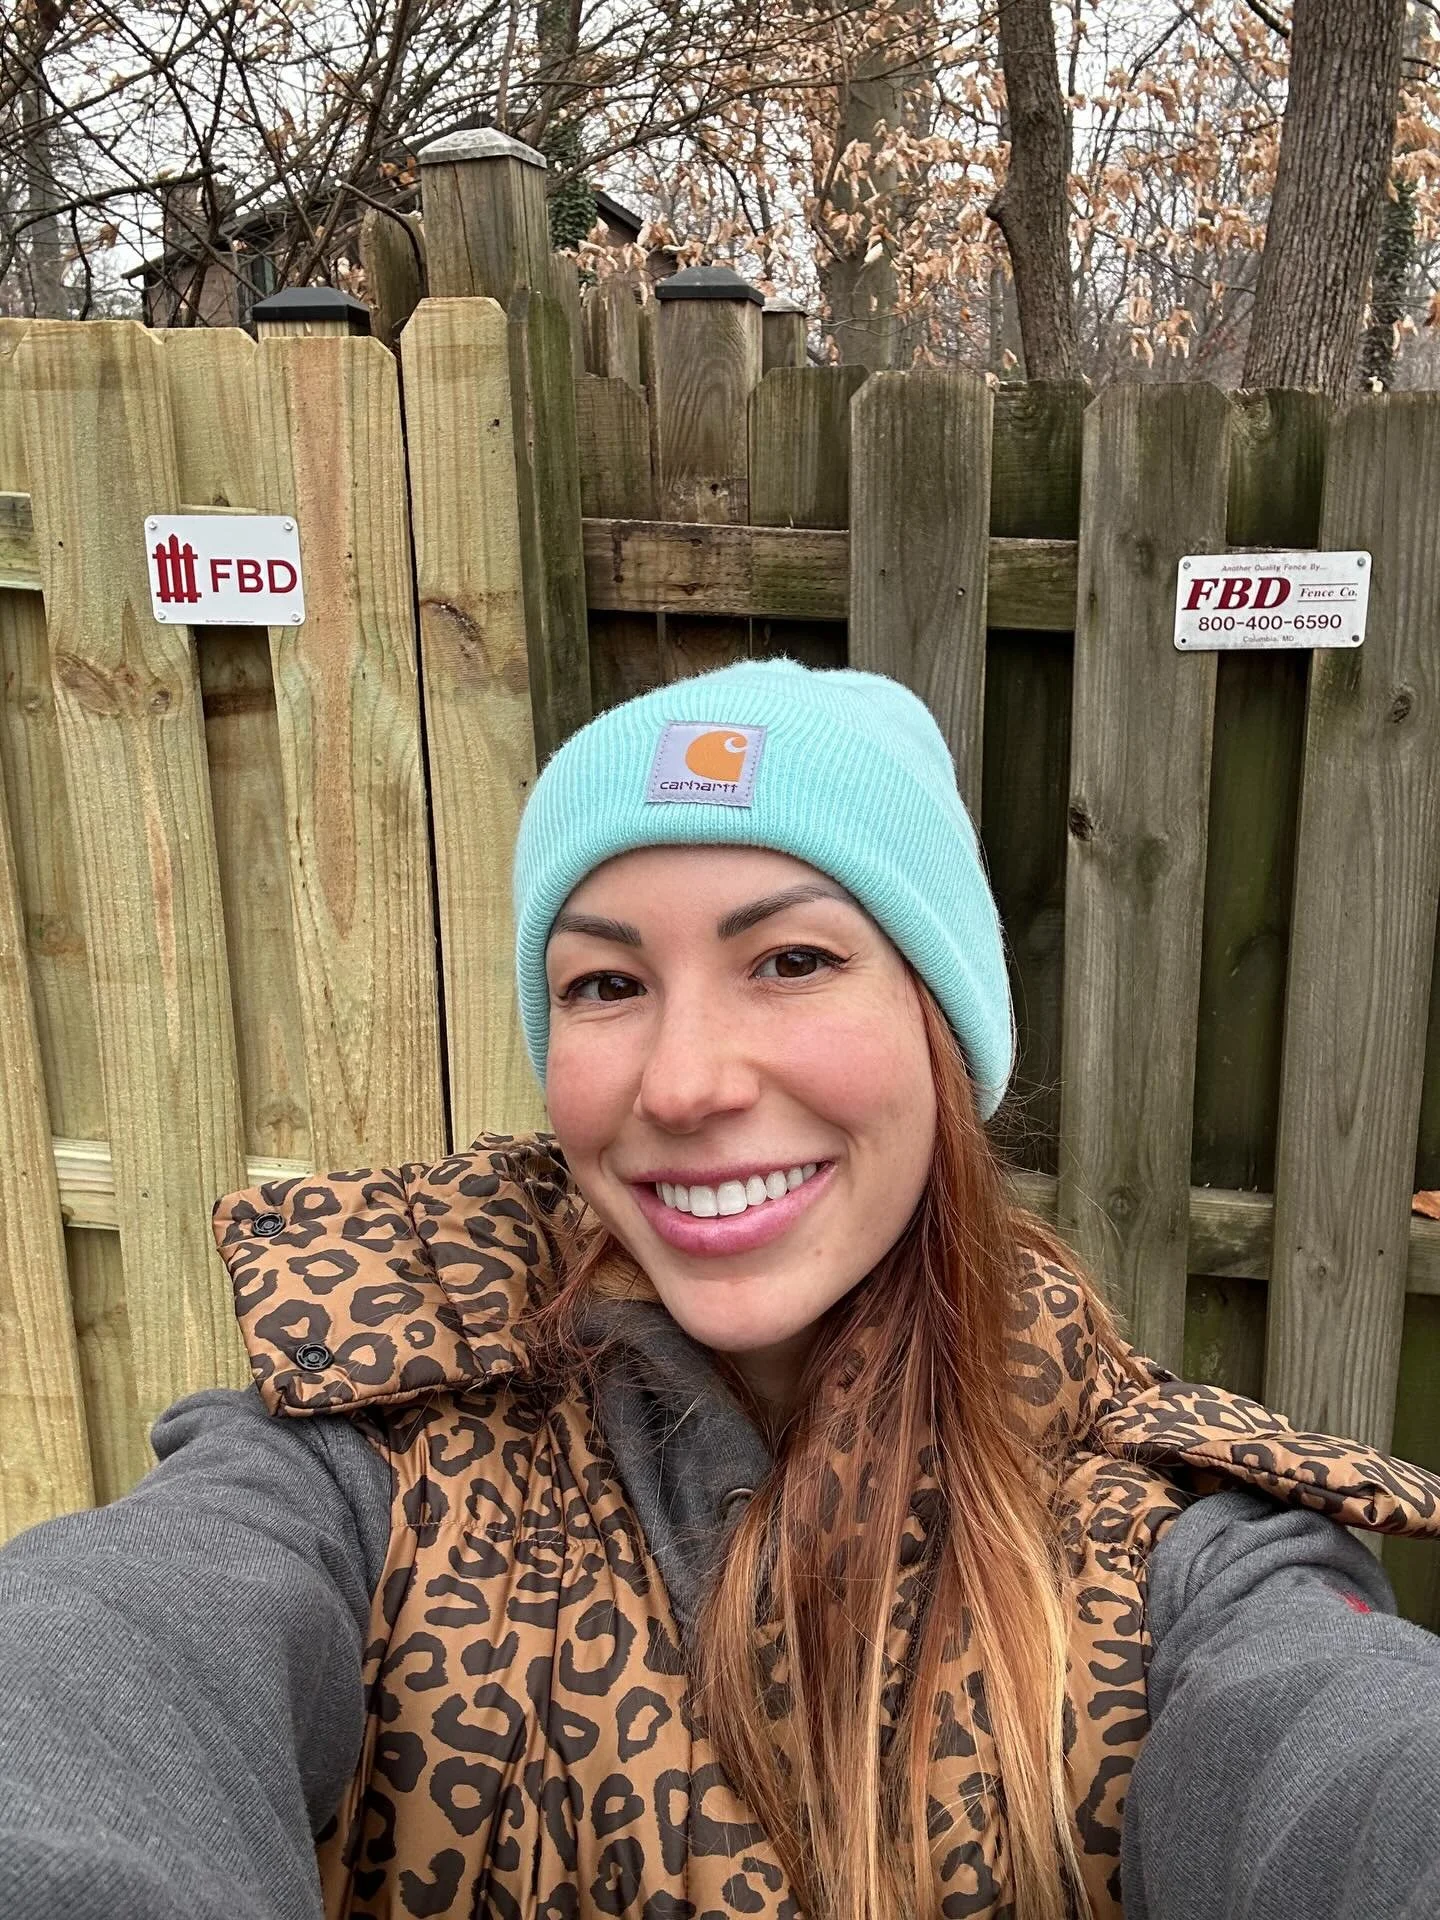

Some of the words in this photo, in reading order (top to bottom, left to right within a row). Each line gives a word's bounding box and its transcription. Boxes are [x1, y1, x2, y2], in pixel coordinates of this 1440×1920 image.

[1254, 564, 1280, 572] Quality
[1284, 563, 1307, 571] Fence
[210, 558, 298, 594] FBD
[1181, 576, 1292, 611] FBD
[1299, 587, 1335, 598] Fence
[1339, 586, 1358, 598] Co.
[1198, 614, 1343, 632] 800-400-6590
[1282, 634, 1295, 642] MD
[660, 780, 738, 794] carhartt
